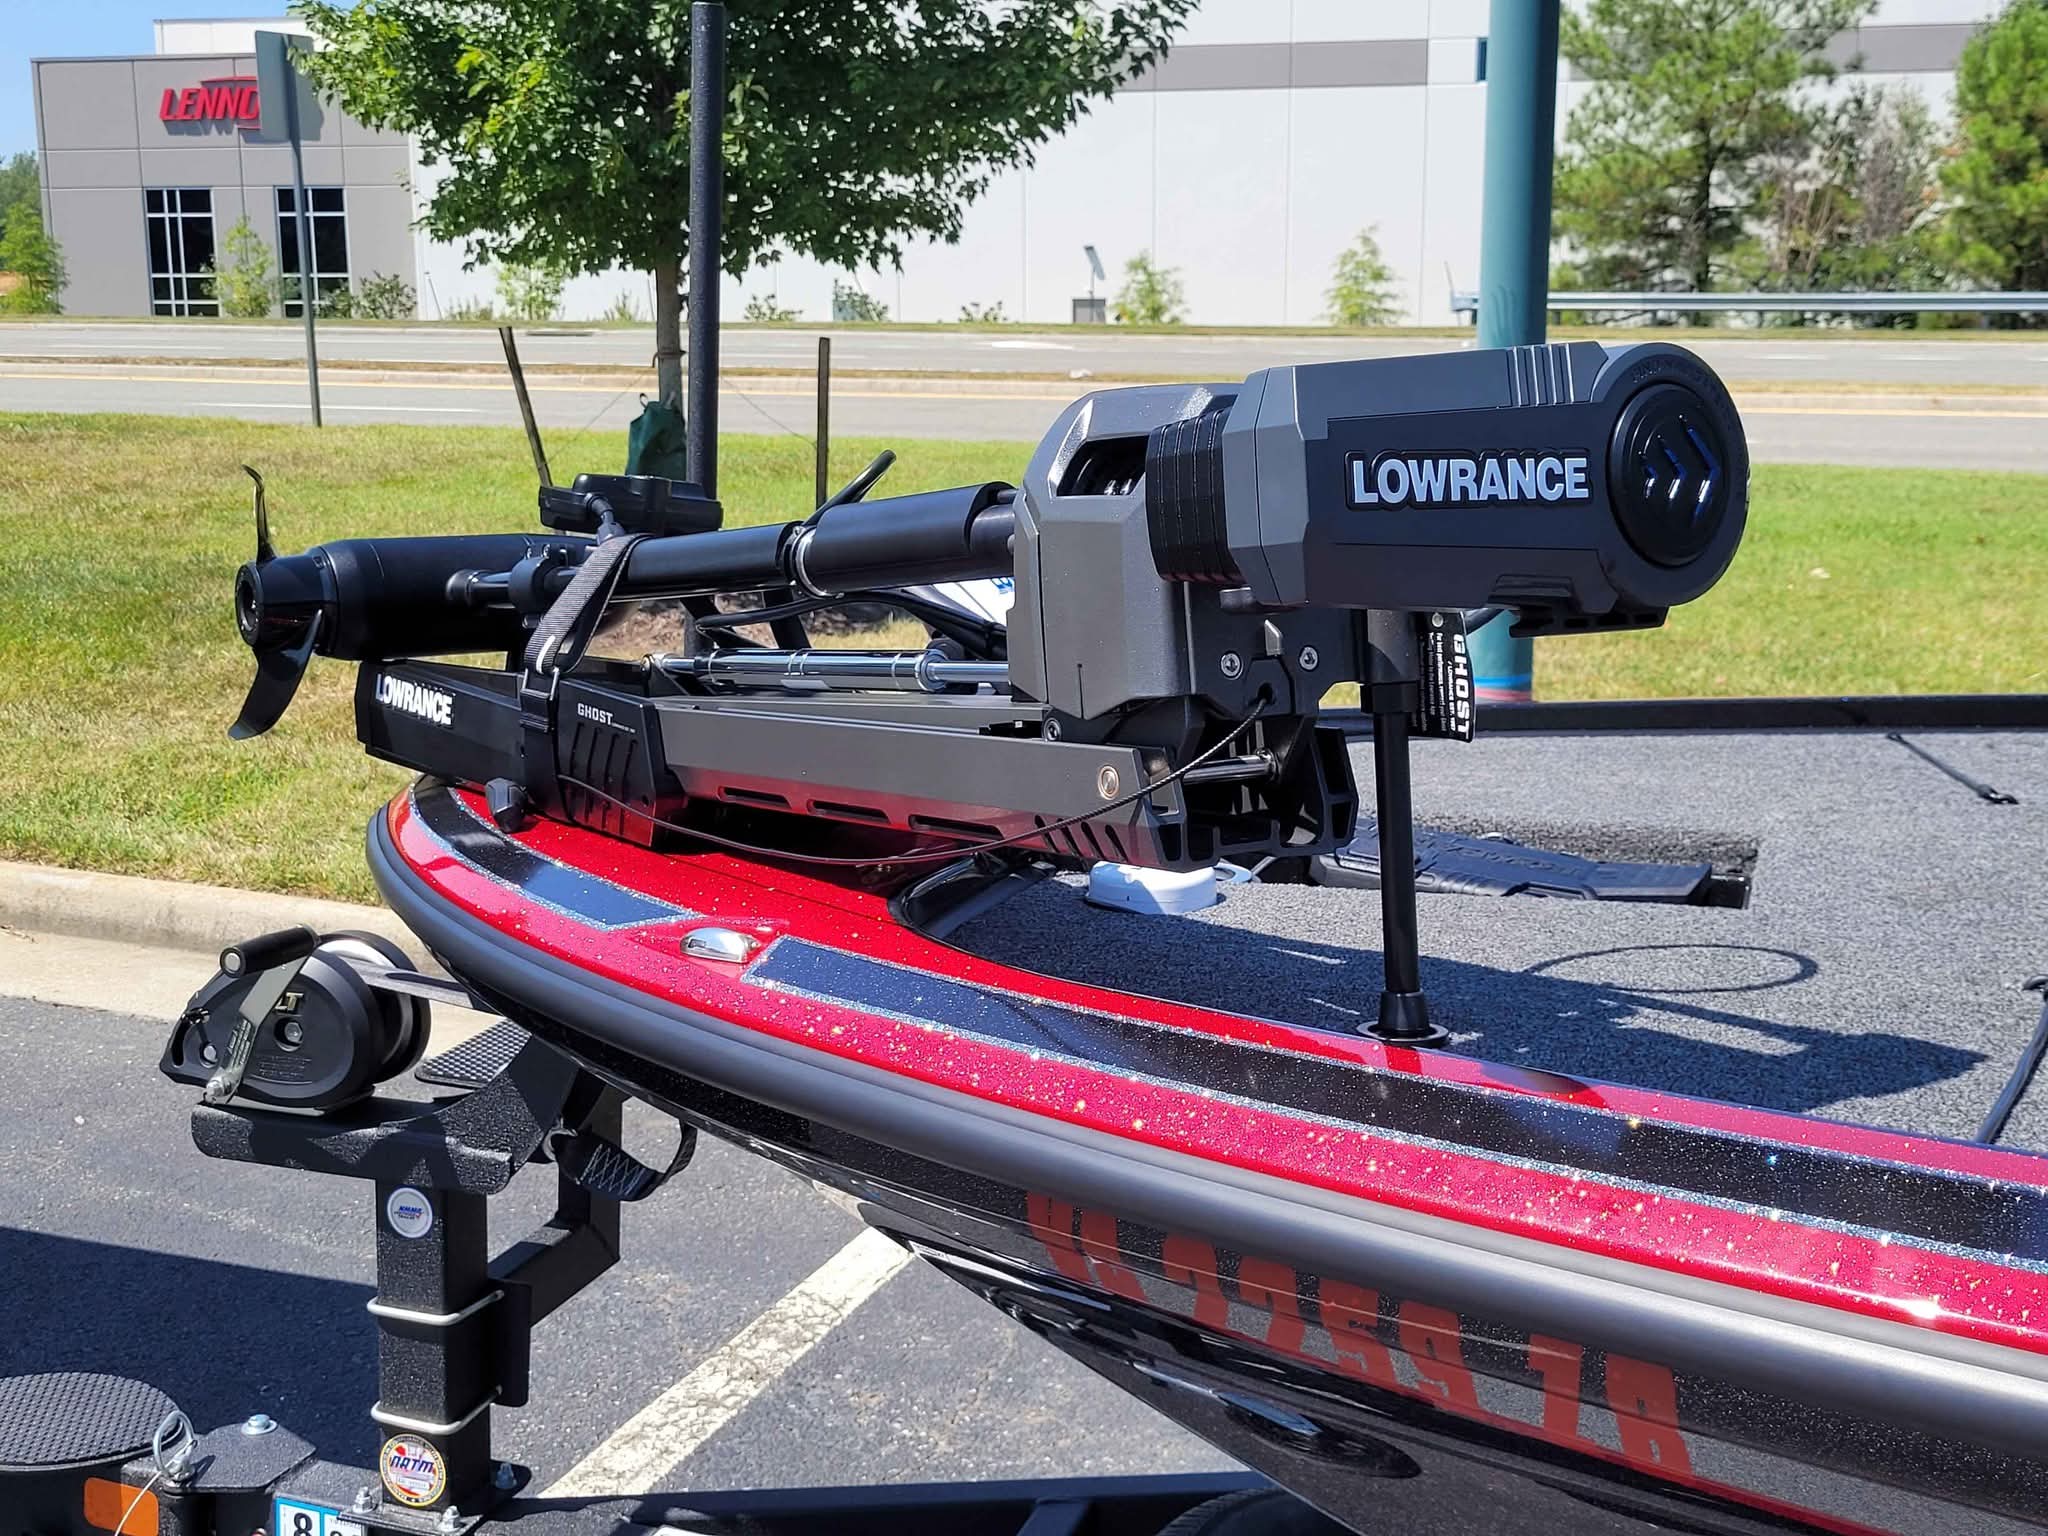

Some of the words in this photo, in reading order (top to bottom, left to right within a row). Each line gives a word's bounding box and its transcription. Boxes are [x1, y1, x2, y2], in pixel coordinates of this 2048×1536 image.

[159, 86, 260, 121] LENNO
[1353, 457, 1589, 504] LOWRANCE
[375, 673, 453, 725] LOWRANCE
[1453, 634, 1470, 739] GHOST
[577, 703, 613, 725] GHOST
